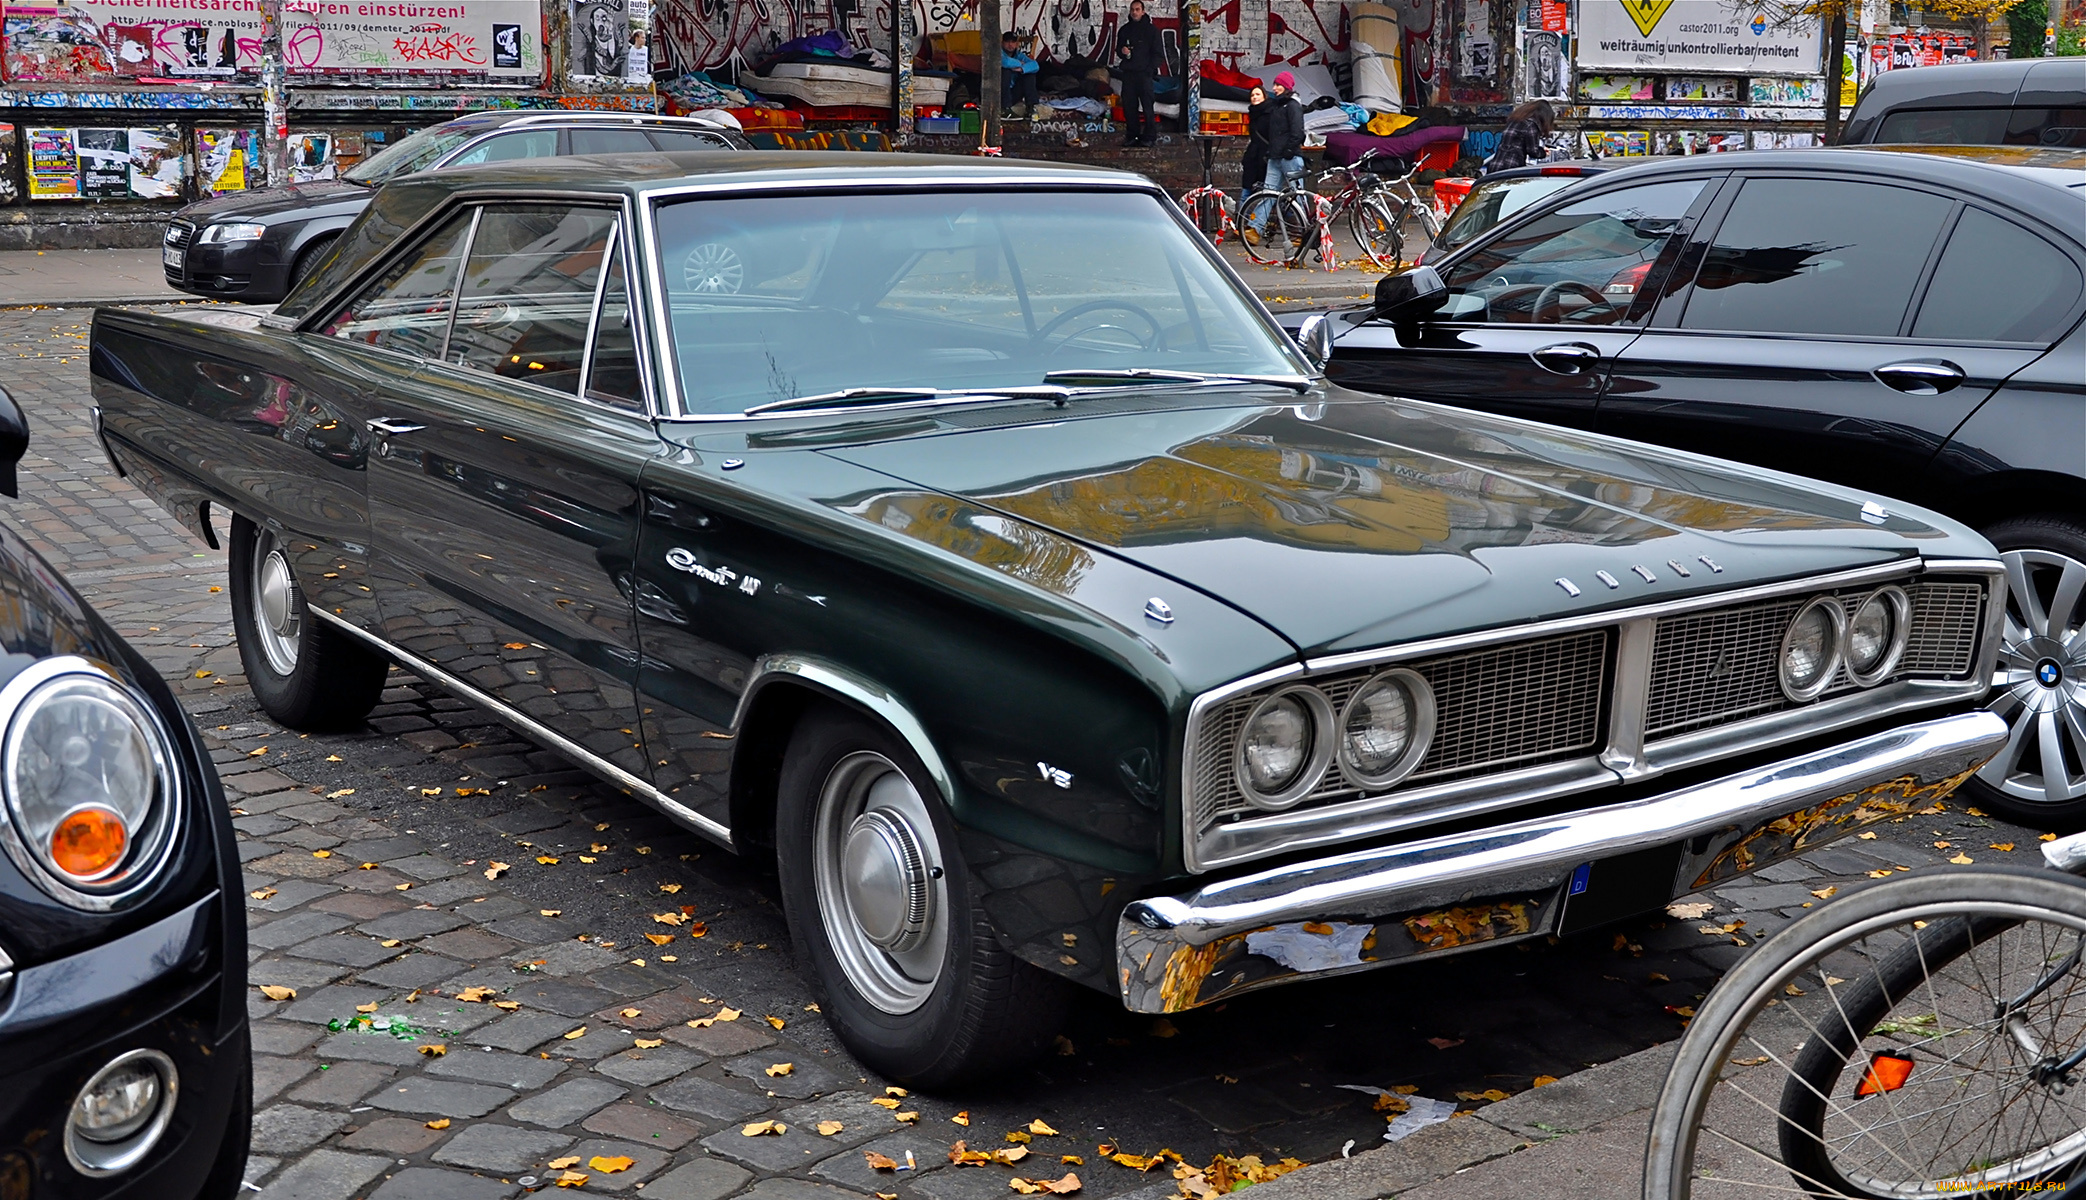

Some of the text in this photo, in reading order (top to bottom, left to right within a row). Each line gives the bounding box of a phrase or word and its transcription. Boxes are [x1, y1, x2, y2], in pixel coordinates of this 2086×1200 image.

[358, 2, 466, 18] einstürzen!
[1679, 23, 1739, 37] castor2011.org
[1575, 881, 1582, 891] D
